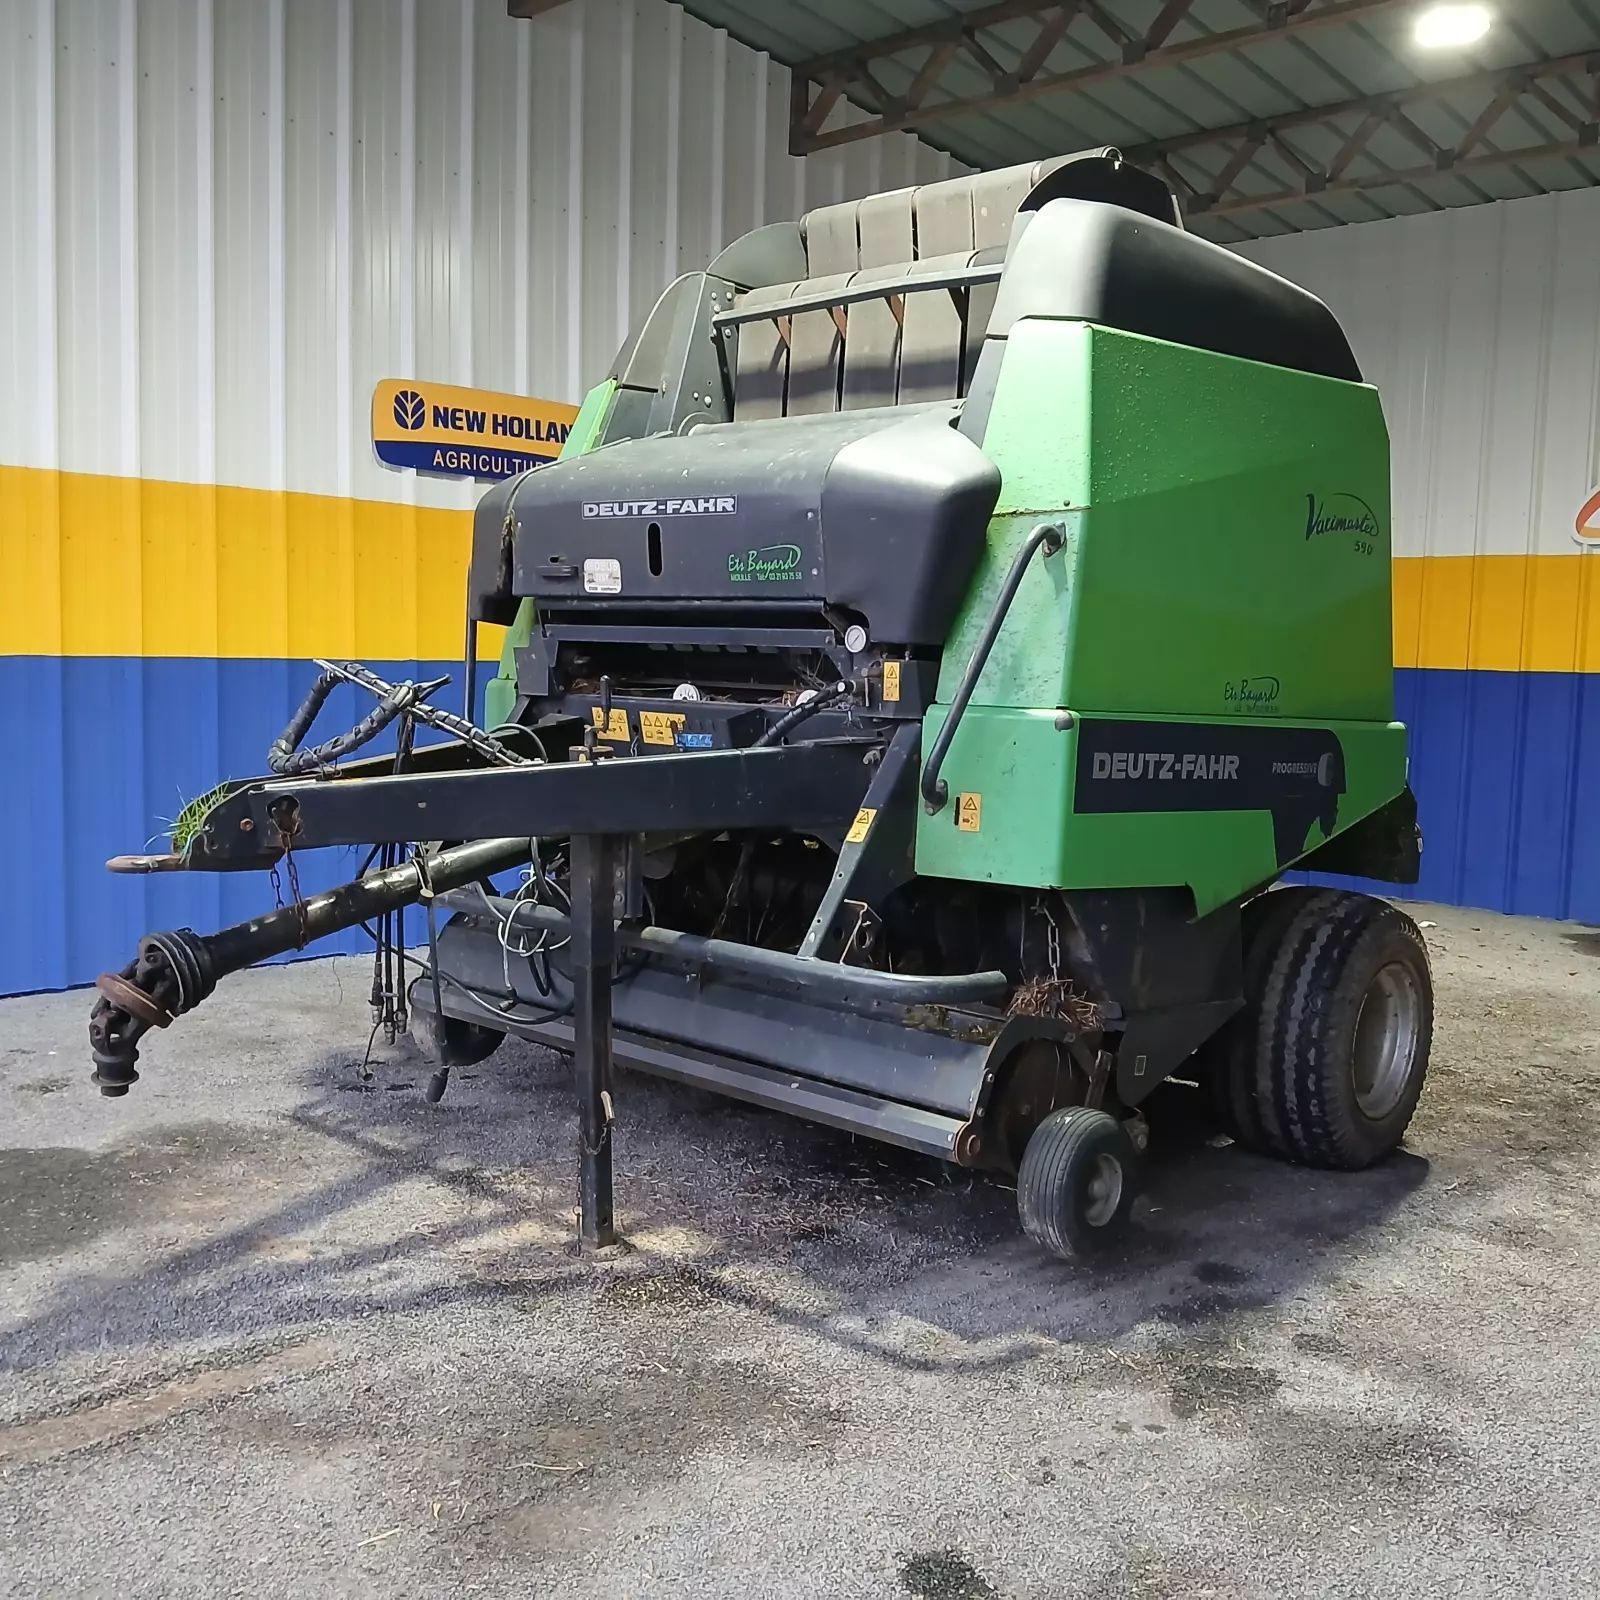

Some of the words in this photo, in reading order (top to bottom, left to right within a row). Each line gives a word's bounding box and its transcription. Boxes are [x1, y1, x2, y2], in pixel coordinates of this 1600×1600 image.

[432, 405, 486, 434] NEW
[492, 413, 573, 444] HOLLAN
[583, 497, 735, 517] DEUTZ-FAHR
[1354, 540, 1373, 555] 590
[747, 544, 802, 579] Bayard
[1092, 752, 1240, 780] DEUTZ-FAHR
[1271, 762, 1319, 774] PROGRESSIVE
